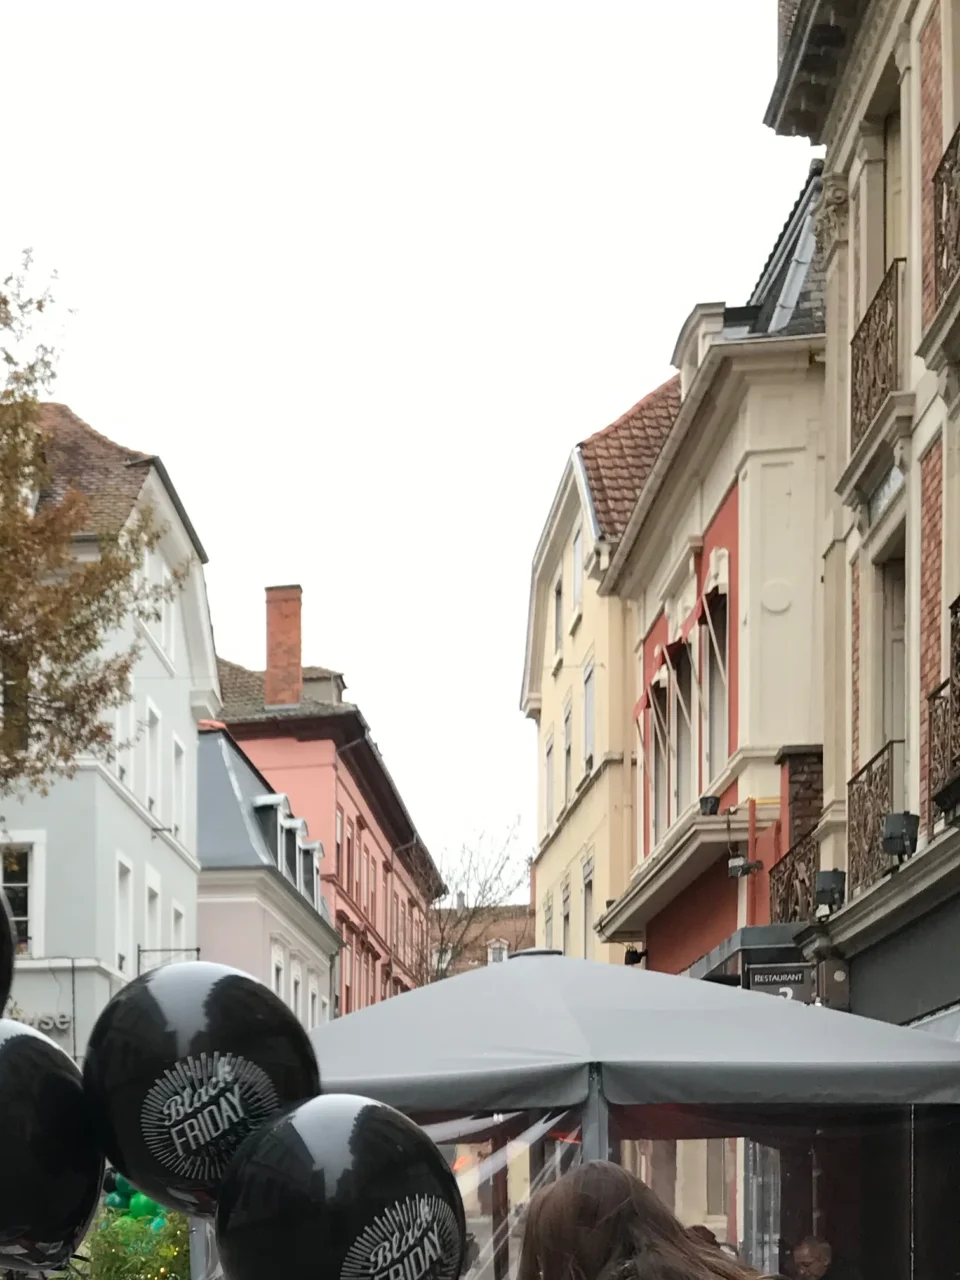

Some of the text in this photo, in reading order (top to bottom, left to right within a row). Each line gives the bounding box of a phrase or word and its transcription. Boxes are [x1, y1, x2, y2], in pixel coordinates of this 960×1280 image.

[754, 973, 803, 983] RESTAURANT
[162, 1056, 236, 1126] Black
[170, 1083, 245, 1156] FRIDAY
[369, 1197, 432, 1274] Black
